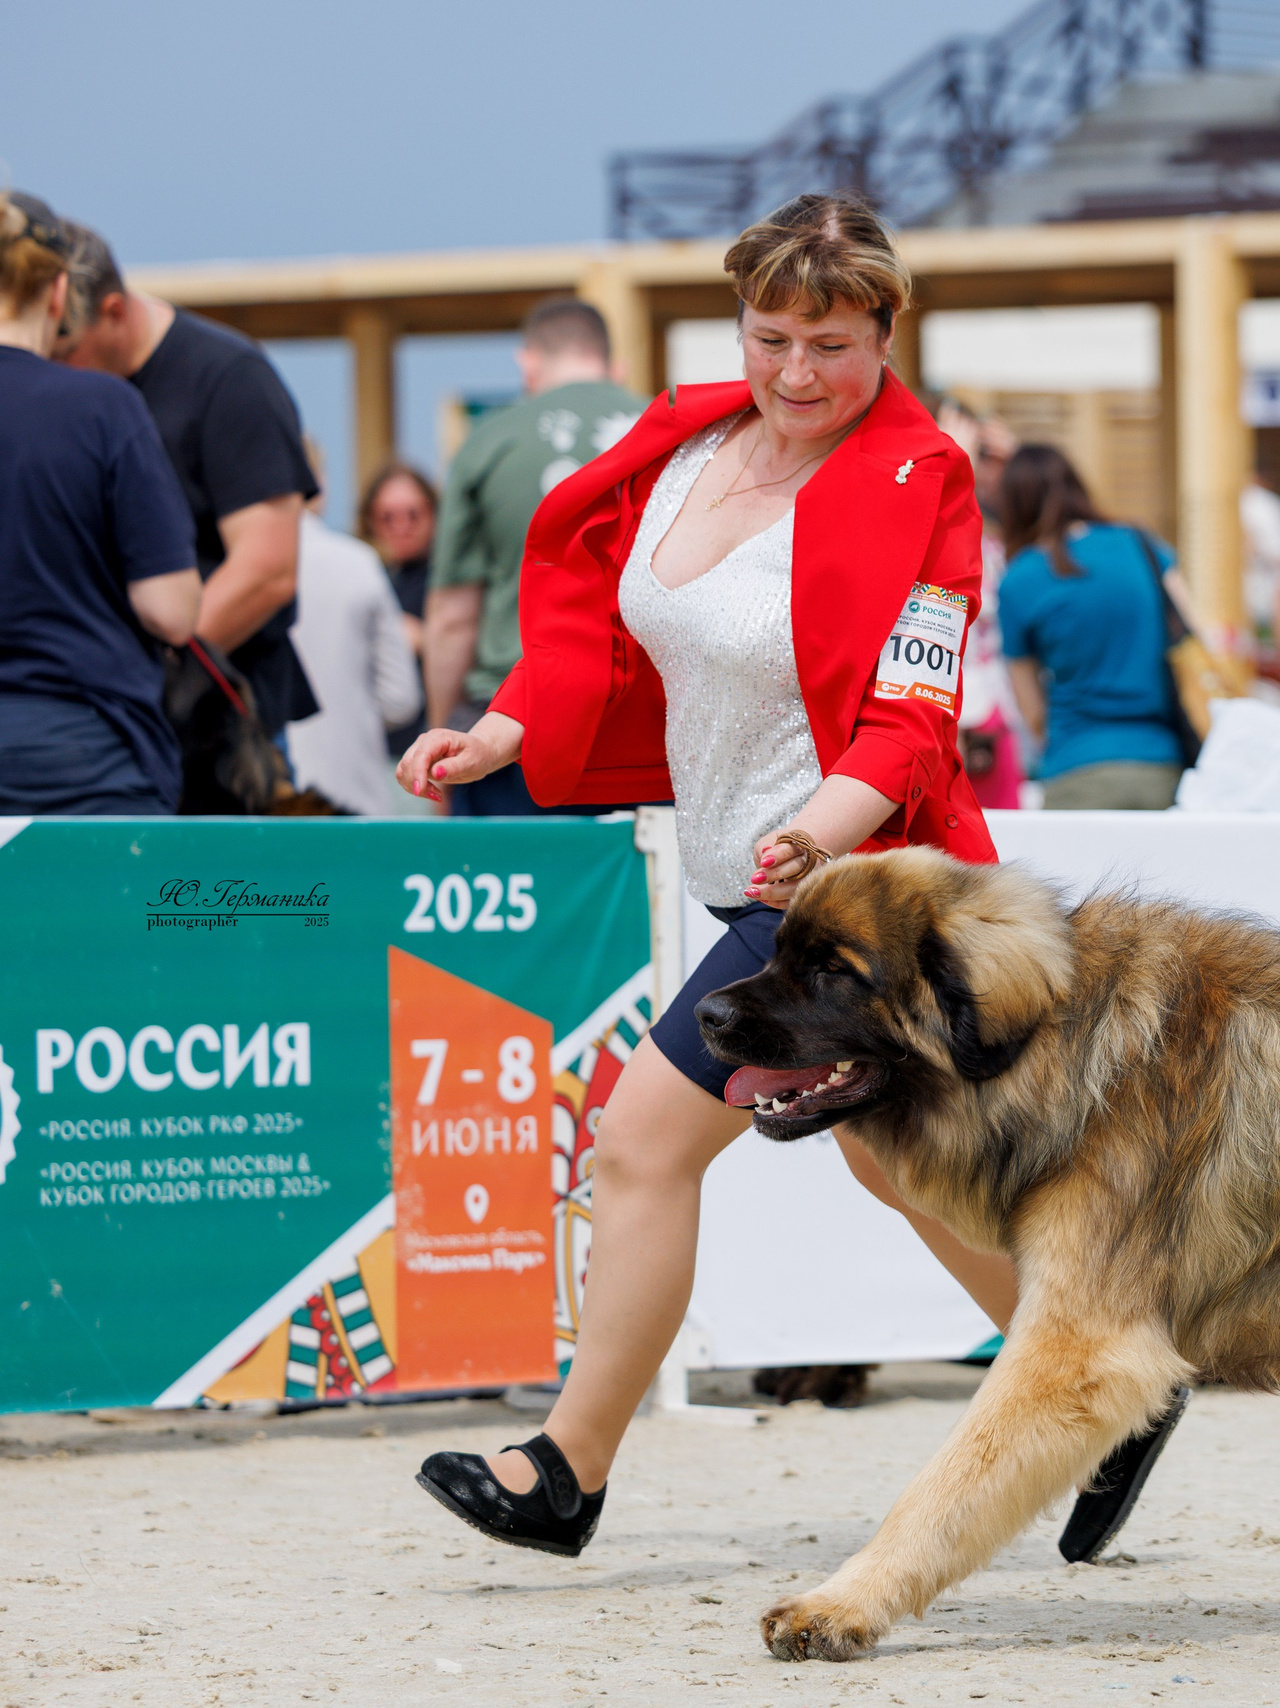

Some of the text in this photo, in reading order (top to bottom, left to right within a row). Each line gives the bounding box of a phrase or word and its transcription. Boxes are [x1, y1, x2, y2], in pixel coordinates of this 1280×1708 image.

[922, 605, 952, 620] РОССИЯ
[890, 635, 954, 676] 1001
[914, 687, 952, 706] 8.06.2025
[403, 872, 538, 933] 2025
[36, 1021, 311, 1094] РОССИЯ
[141, 1115, 205, 1137] КУБОК
[209, 1114, 248, 1135] РКФ
[411, 1115, 538, 1157] ИЮНЯ
[141, 1156, 206, 1179] КУБОК
[209, 1153, 294, 1176] МОСКВЫ
[297, 1151, 311, 1174] &
[40, 1184, 106, 1207] КУБОК
